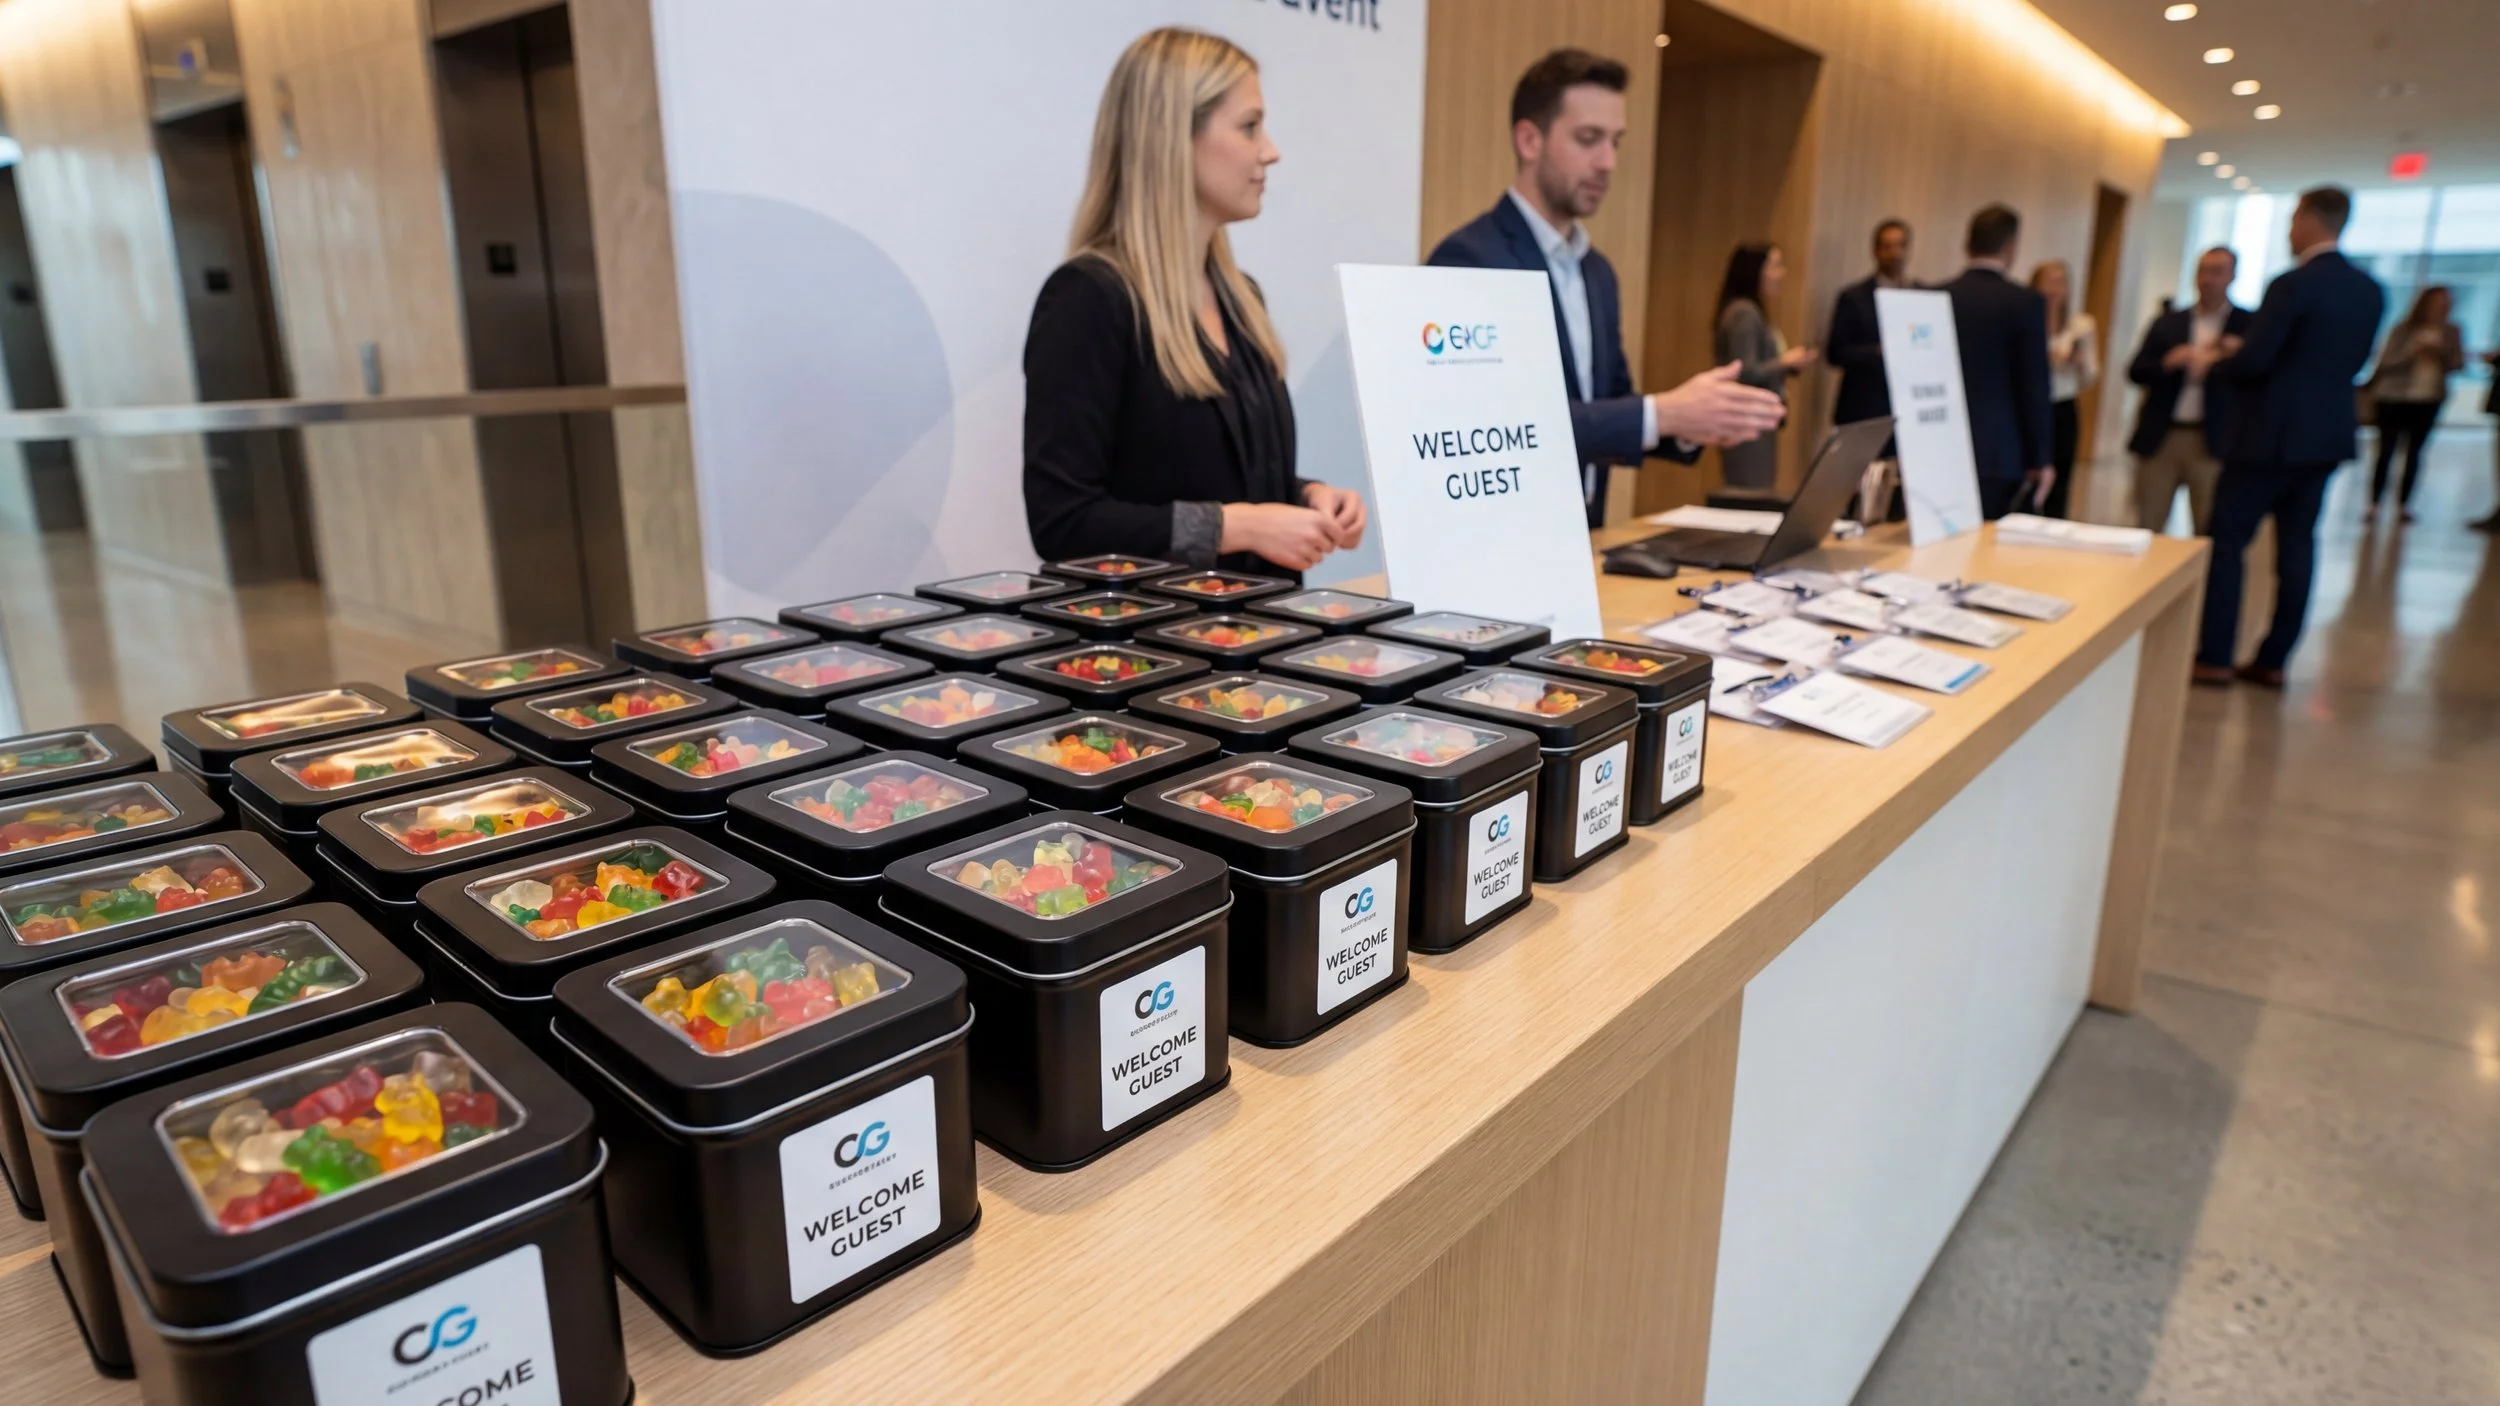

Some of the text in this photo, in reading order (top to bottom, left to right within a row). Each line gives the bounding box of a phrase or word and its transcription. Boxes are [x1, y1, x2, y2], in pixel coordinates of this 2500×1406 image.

[1413, 424, 1538, 460] WELCOME
[1446, 467, 1521, 500] GUEST
[1583, 794, 1620, 823] WELCOME
[1588, 814, 1612, 835] GUEST
[1473, 851, 1519, 886] WELCOME
[1481, 873, 1511, 899] GUEST
[1345, 886, 1374, 919] CG
[1326, 928, 1388, 971] WELCOME
[1337, 953, 1377, 985] GUEST
[1134, 981, 1175, 1020] CG
[1111, 1025, 1197, 1082] WELCOME
[1129, 1055, 1183, 1096] GUEST
[833, 1120, 890, 1168] CG
[803, 1169, 925, 1242] WELCOME
[831, 1206, 906, 1257] GUEST
[392, 1304, 478, 1365] CG
